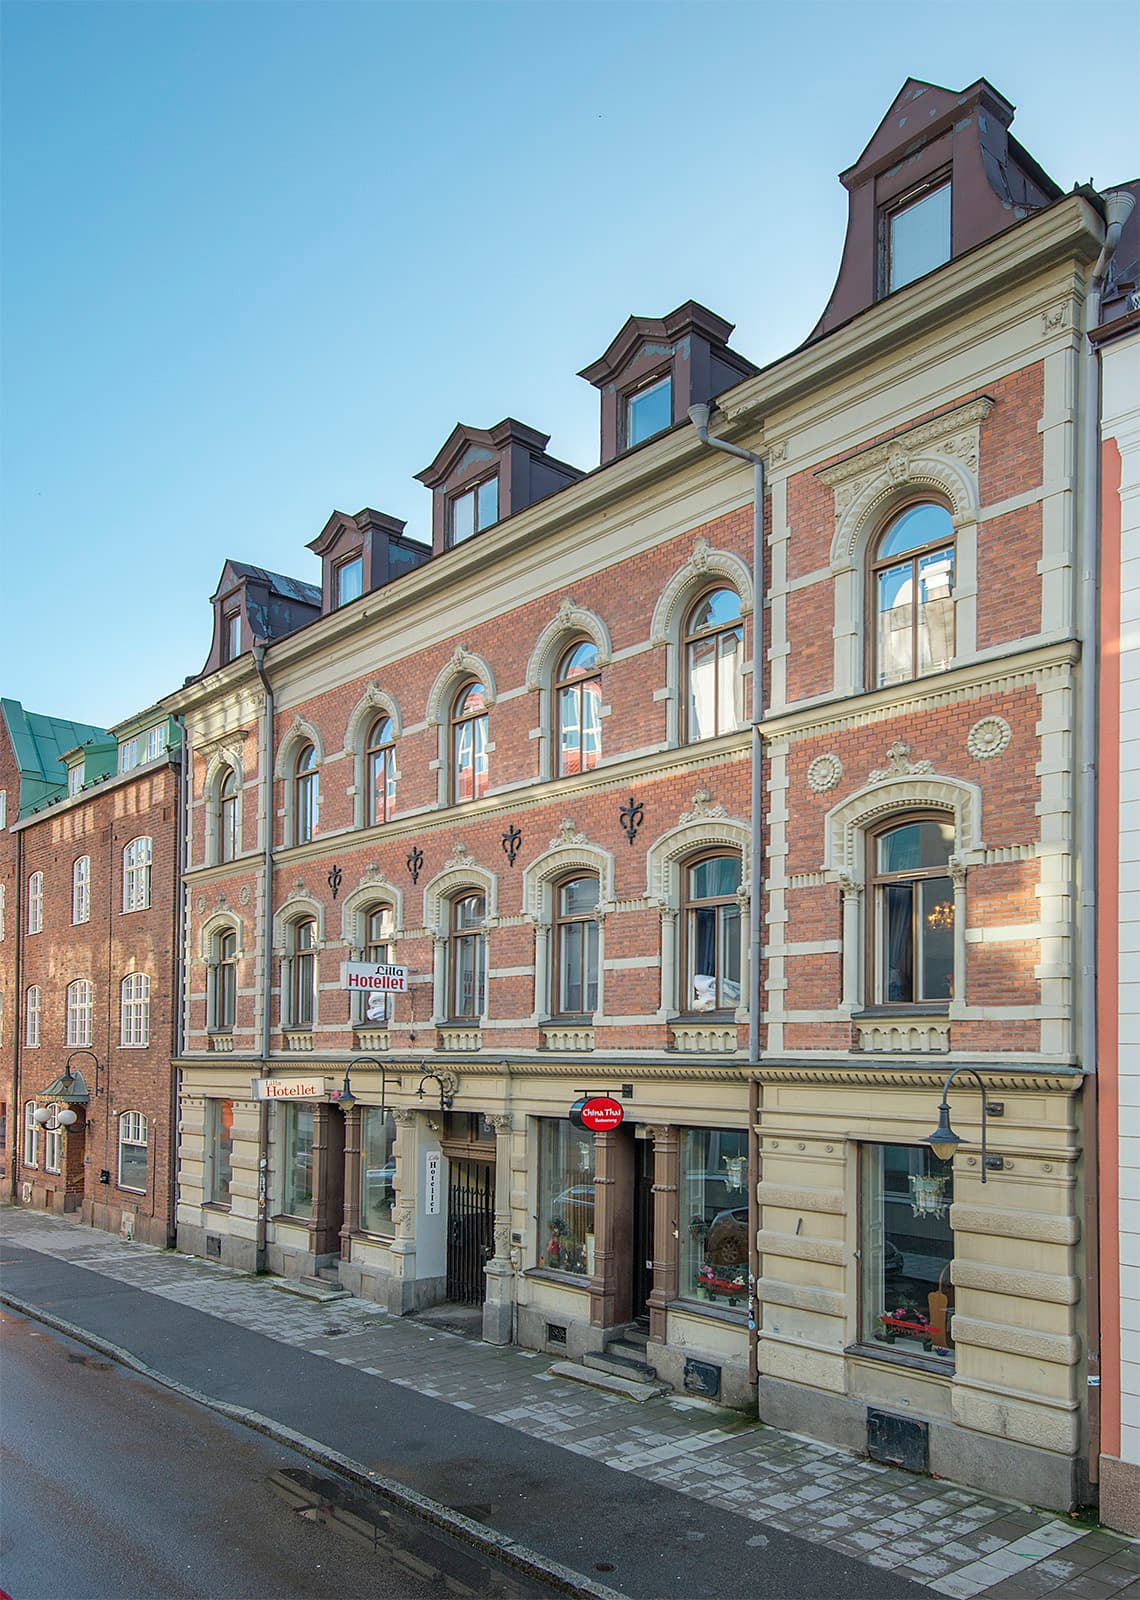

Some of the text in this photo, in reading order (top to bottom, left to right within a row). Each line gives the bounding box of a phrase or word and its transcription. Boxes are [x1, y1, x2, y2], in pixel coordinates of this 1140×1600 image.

[375, 966, 403, 976] Lilla
[348, 973, 405, 990] Hotellet
[266, 1085, 316, 1097] Hotellet
[582, 1108, 621, 1117] China Thai
